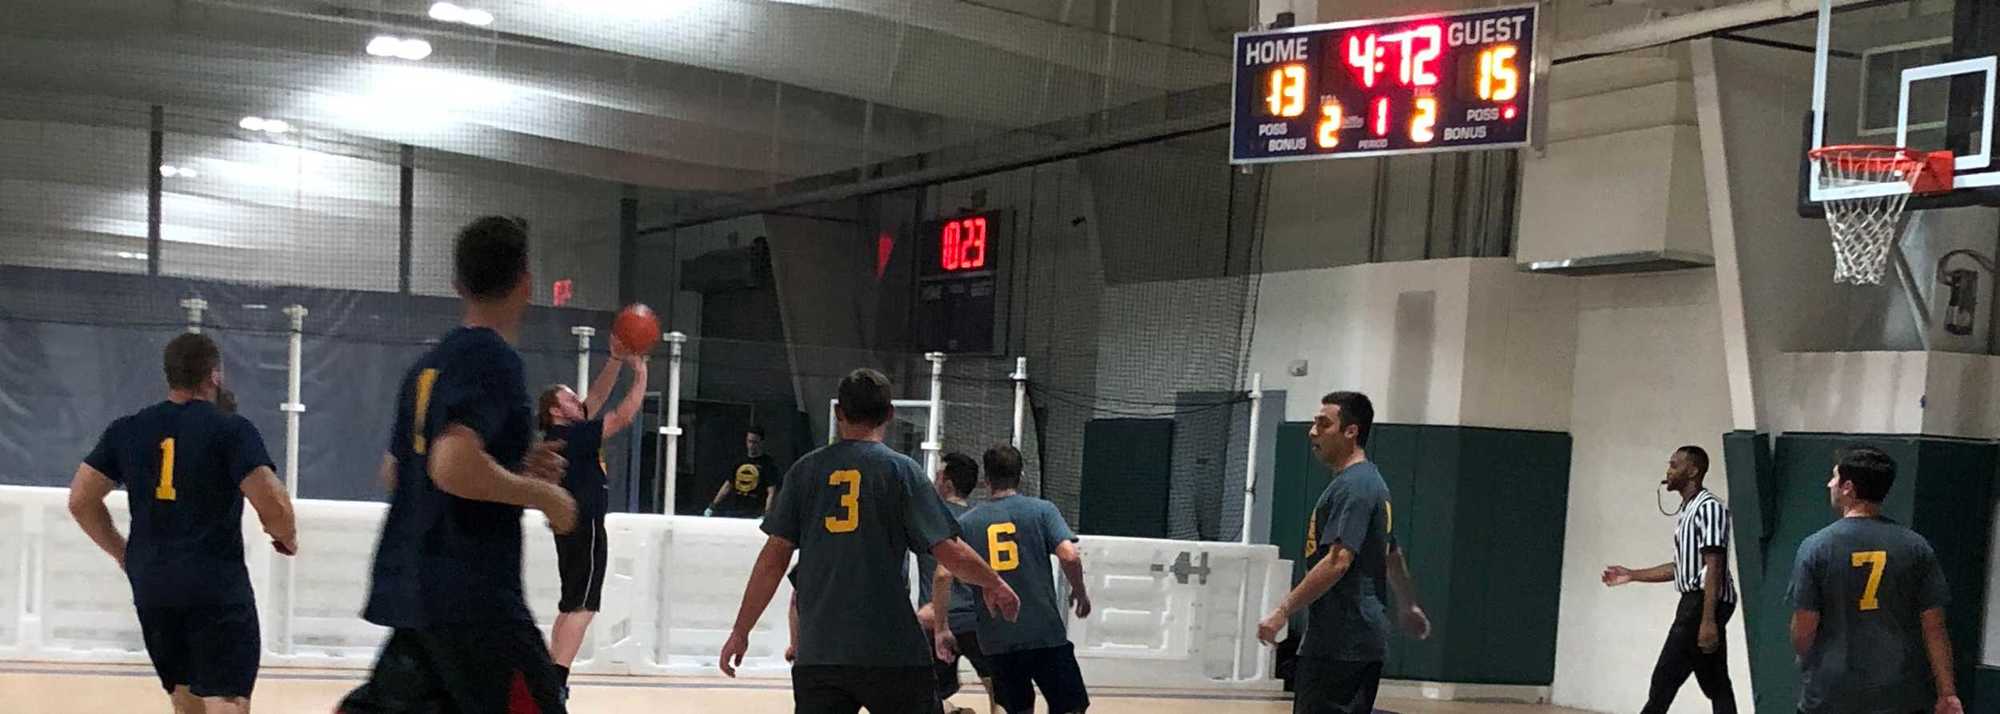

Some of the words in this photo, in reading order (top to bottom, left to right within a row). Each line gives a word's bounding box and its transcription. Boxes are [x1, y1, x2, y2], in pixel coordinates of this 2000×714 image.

[1246, 37, 1309, 65] HOME
[1448, 16, 1527, 46] GUEST
[1267, 63, 1307, 117] 13
[1478, 44, 1519, 101] 15
[1258, 122, 1288, 137] POSS
[1318, 104, 1342, 148] 2
[1374, 97, 1387, 136] 1
[1411, 97, 1436, 142] 2
[1443, 125, 1487, 141] BONUS
[1466, 107, 1499, 122] POSS
[1268, 136, 1307, 152] BONUS
[155, 437, 177, 501] 1
[824, 468, 862, 533] 3
[986, 521, 1020, 572] 6
[1851, 550, 1887, 611] 7
